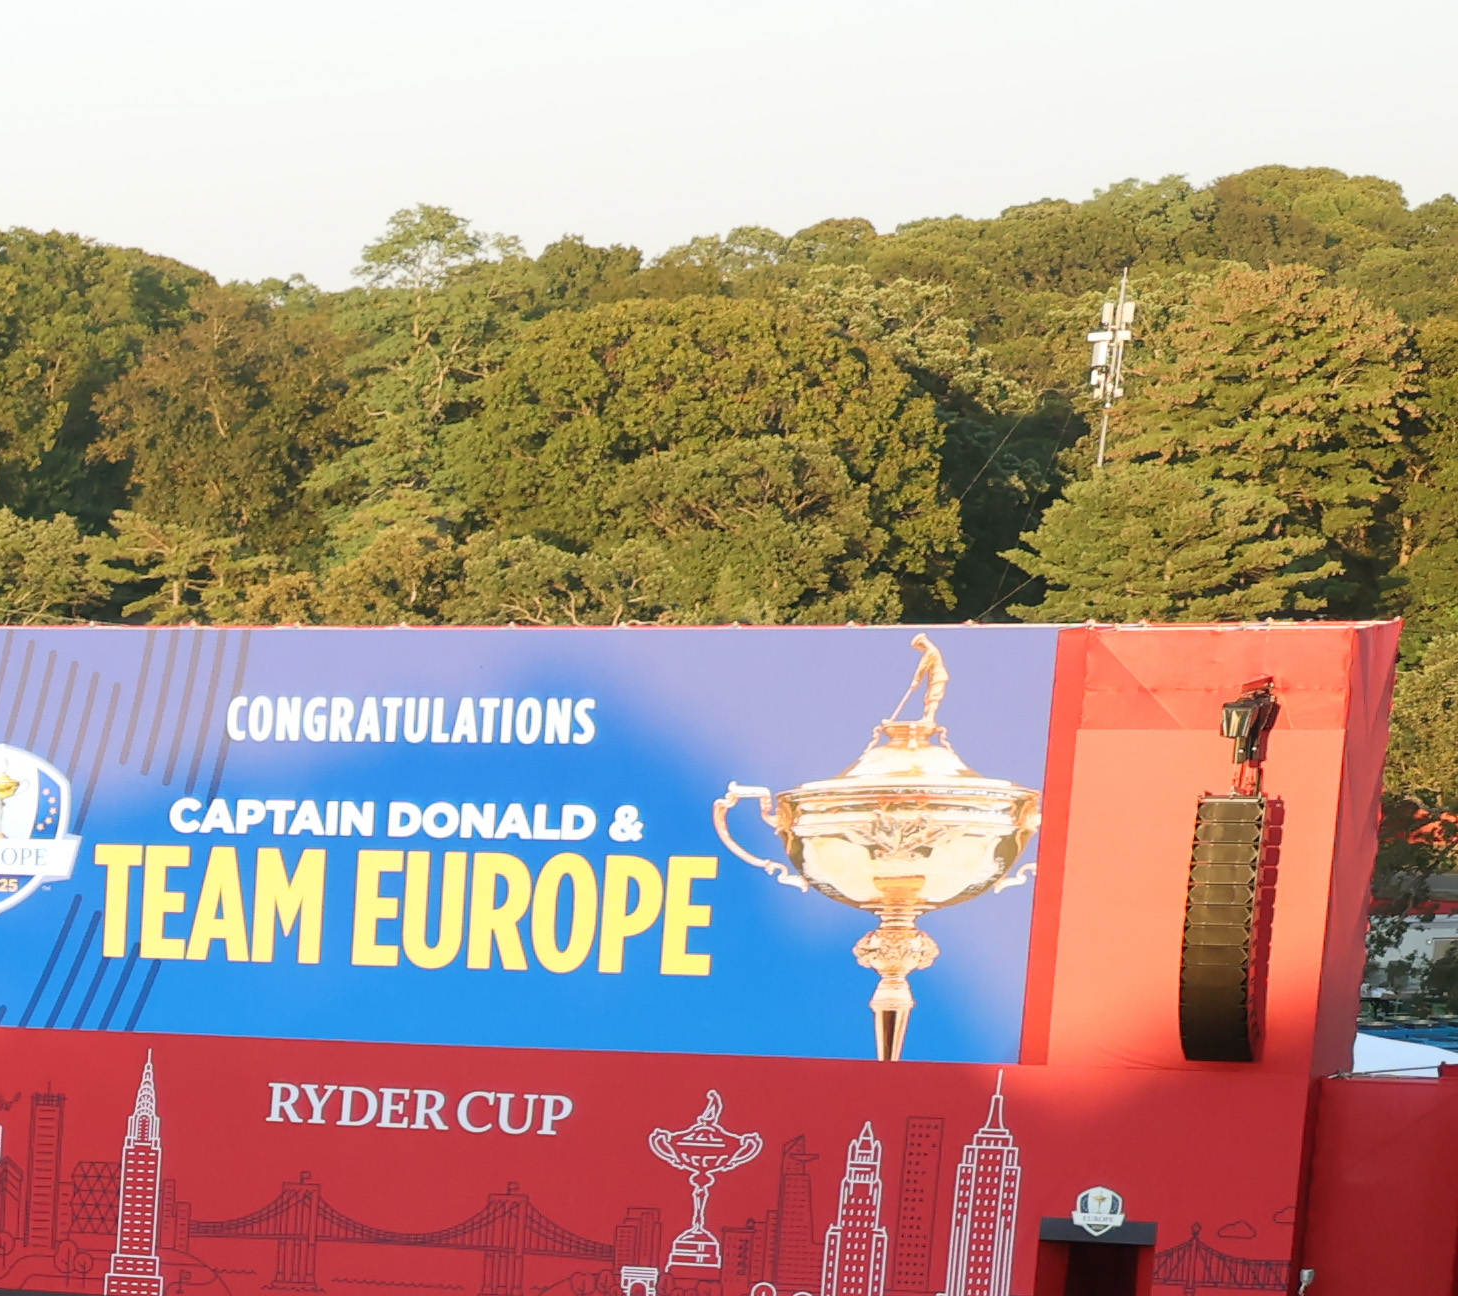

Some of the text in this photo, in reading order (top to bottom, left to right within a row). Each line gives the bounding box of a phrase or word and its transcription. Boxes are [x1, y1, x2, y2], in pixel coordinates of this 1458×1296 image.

[225, 694, 597, 745] CONGRATULATIONS
[168, 797, 645, 843] CAPTAIN DONALD &
[94, 845, 720, 977] TEAM EUROPE
[265, 1082, 573, 1136] RYDER CUP
